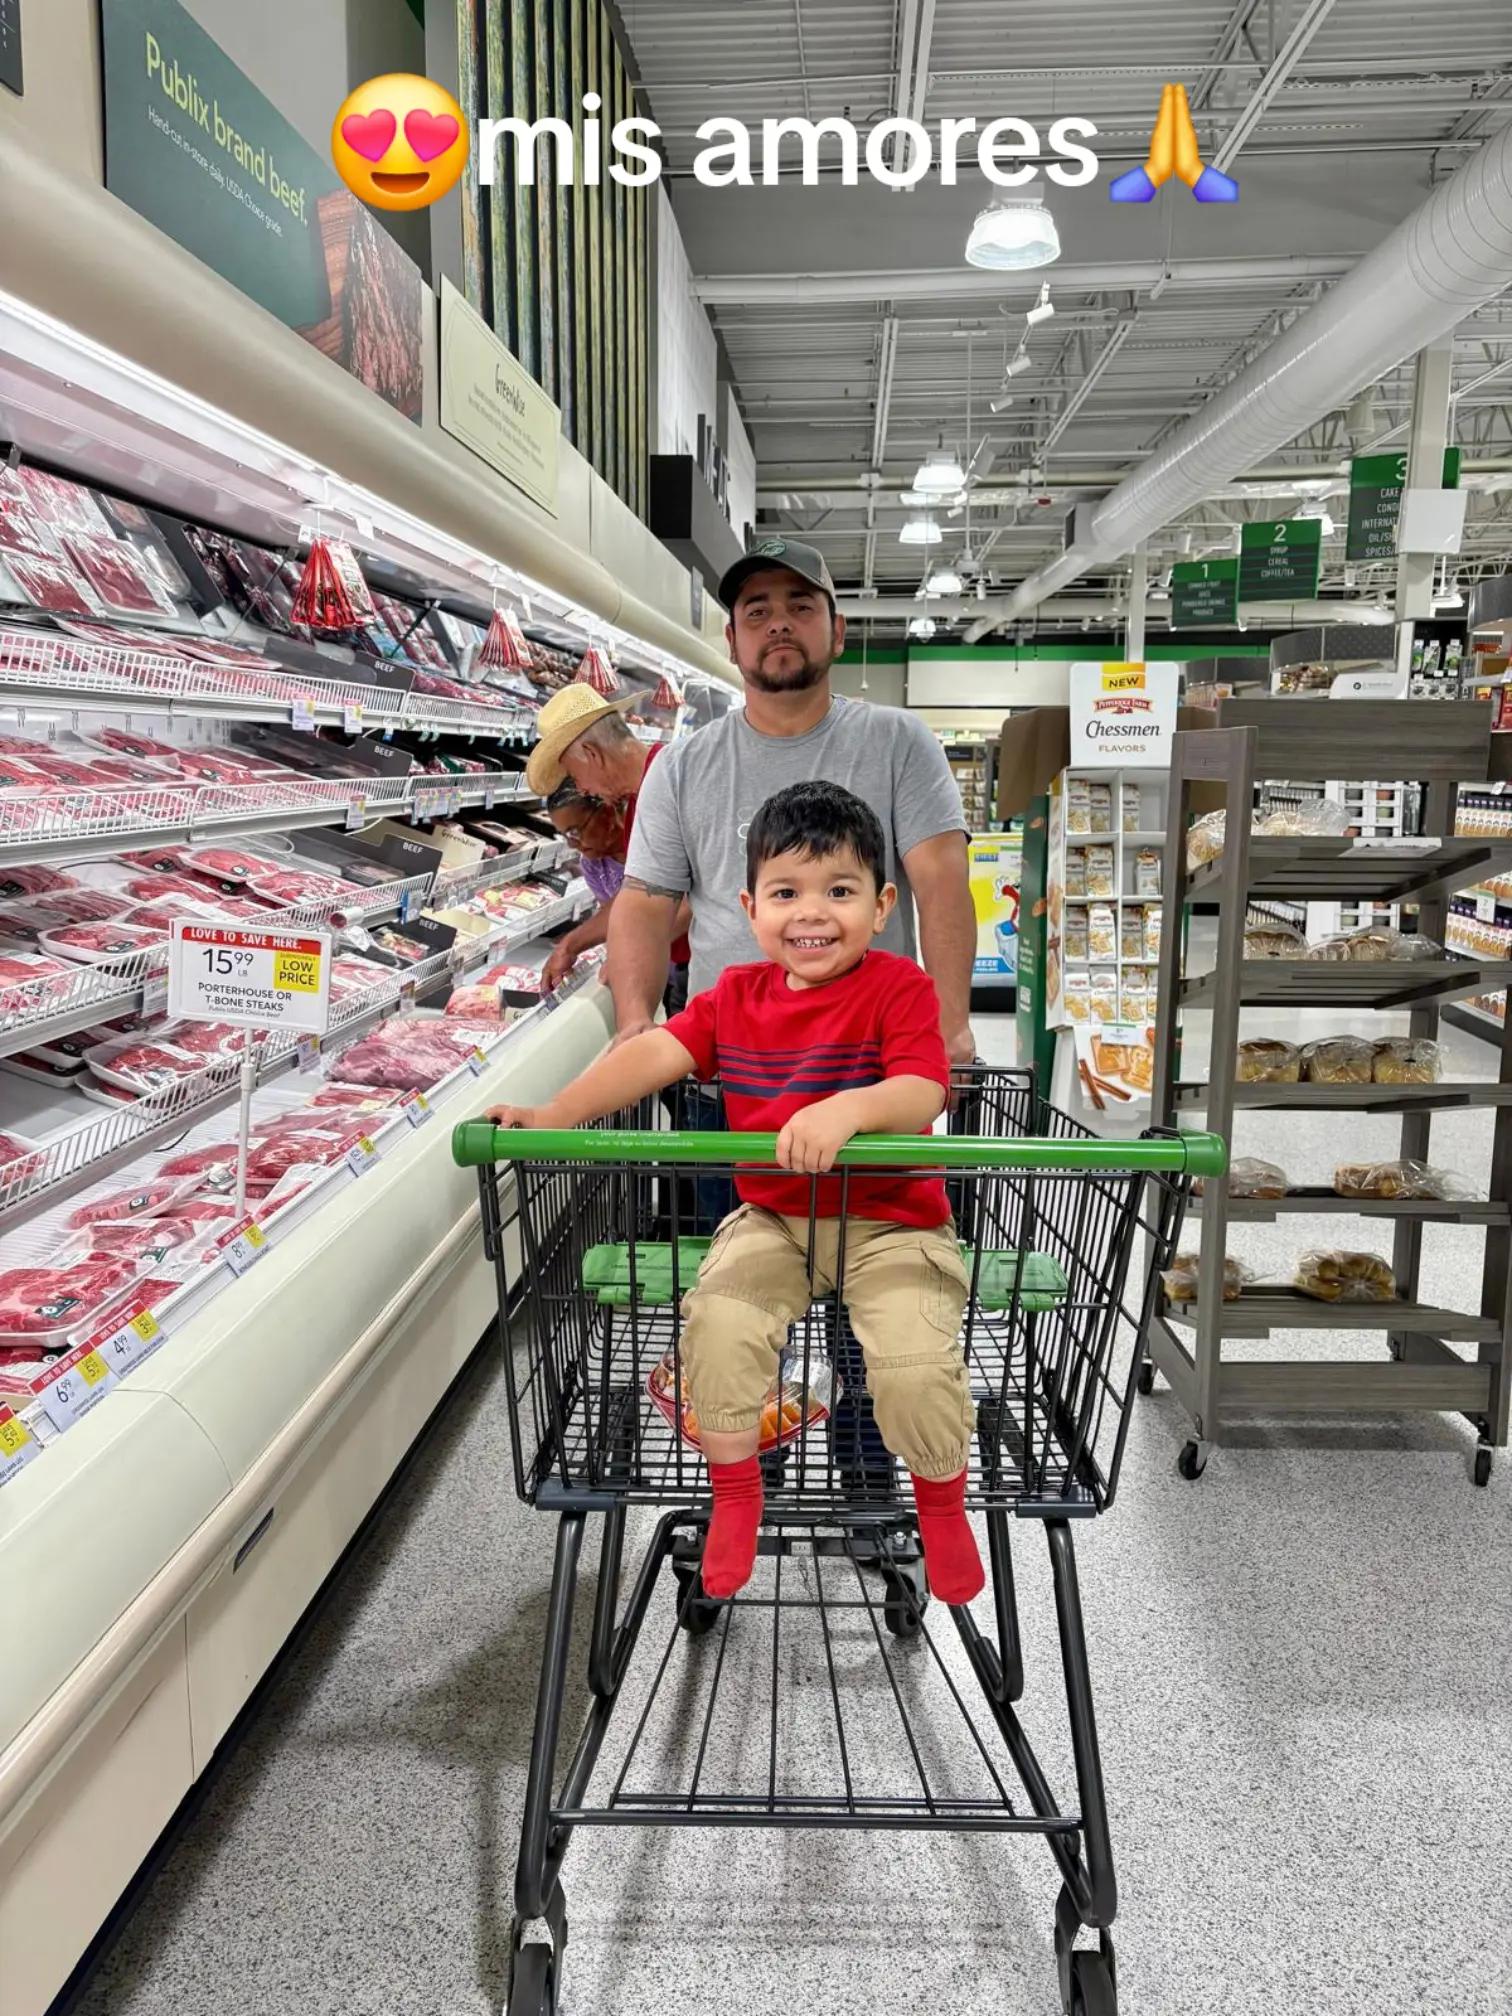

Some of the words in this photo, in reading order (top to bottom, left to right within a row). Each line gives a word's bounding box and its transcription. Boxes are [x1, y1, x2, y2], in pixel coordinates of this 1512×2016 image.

[146, 32, 210, 132] Publix
[213, 100, 265, 187] brand
[1273, 523, 1287, 543] 2
[1201, 563, 1209, 579] 1
[373, 660, 396, 673] BEEF
[1108, 676, 1140, 689] NEW
[1085, 720, 1160, 739] Chessmen
[373, 744, 395, 758] BEEF
[1098, 744, 1147, 753] FLAVORS
[402, 841, 424, 854] BEEF
[190, 927, 217, 943] LOVE
[223, 931, 236, 943] TO
[241, 933, 267, 947] SAVE
[282, 960, 314, 973] LOW
[279, 972, 317, 986] PRICE
[197, 982, 274, 999] PORTERHOUSE
[276, 991, 292, 1001] OR
[204, 995, 244, 1008] T-BONE
[245, 999, 285, 1012] STEAKS
